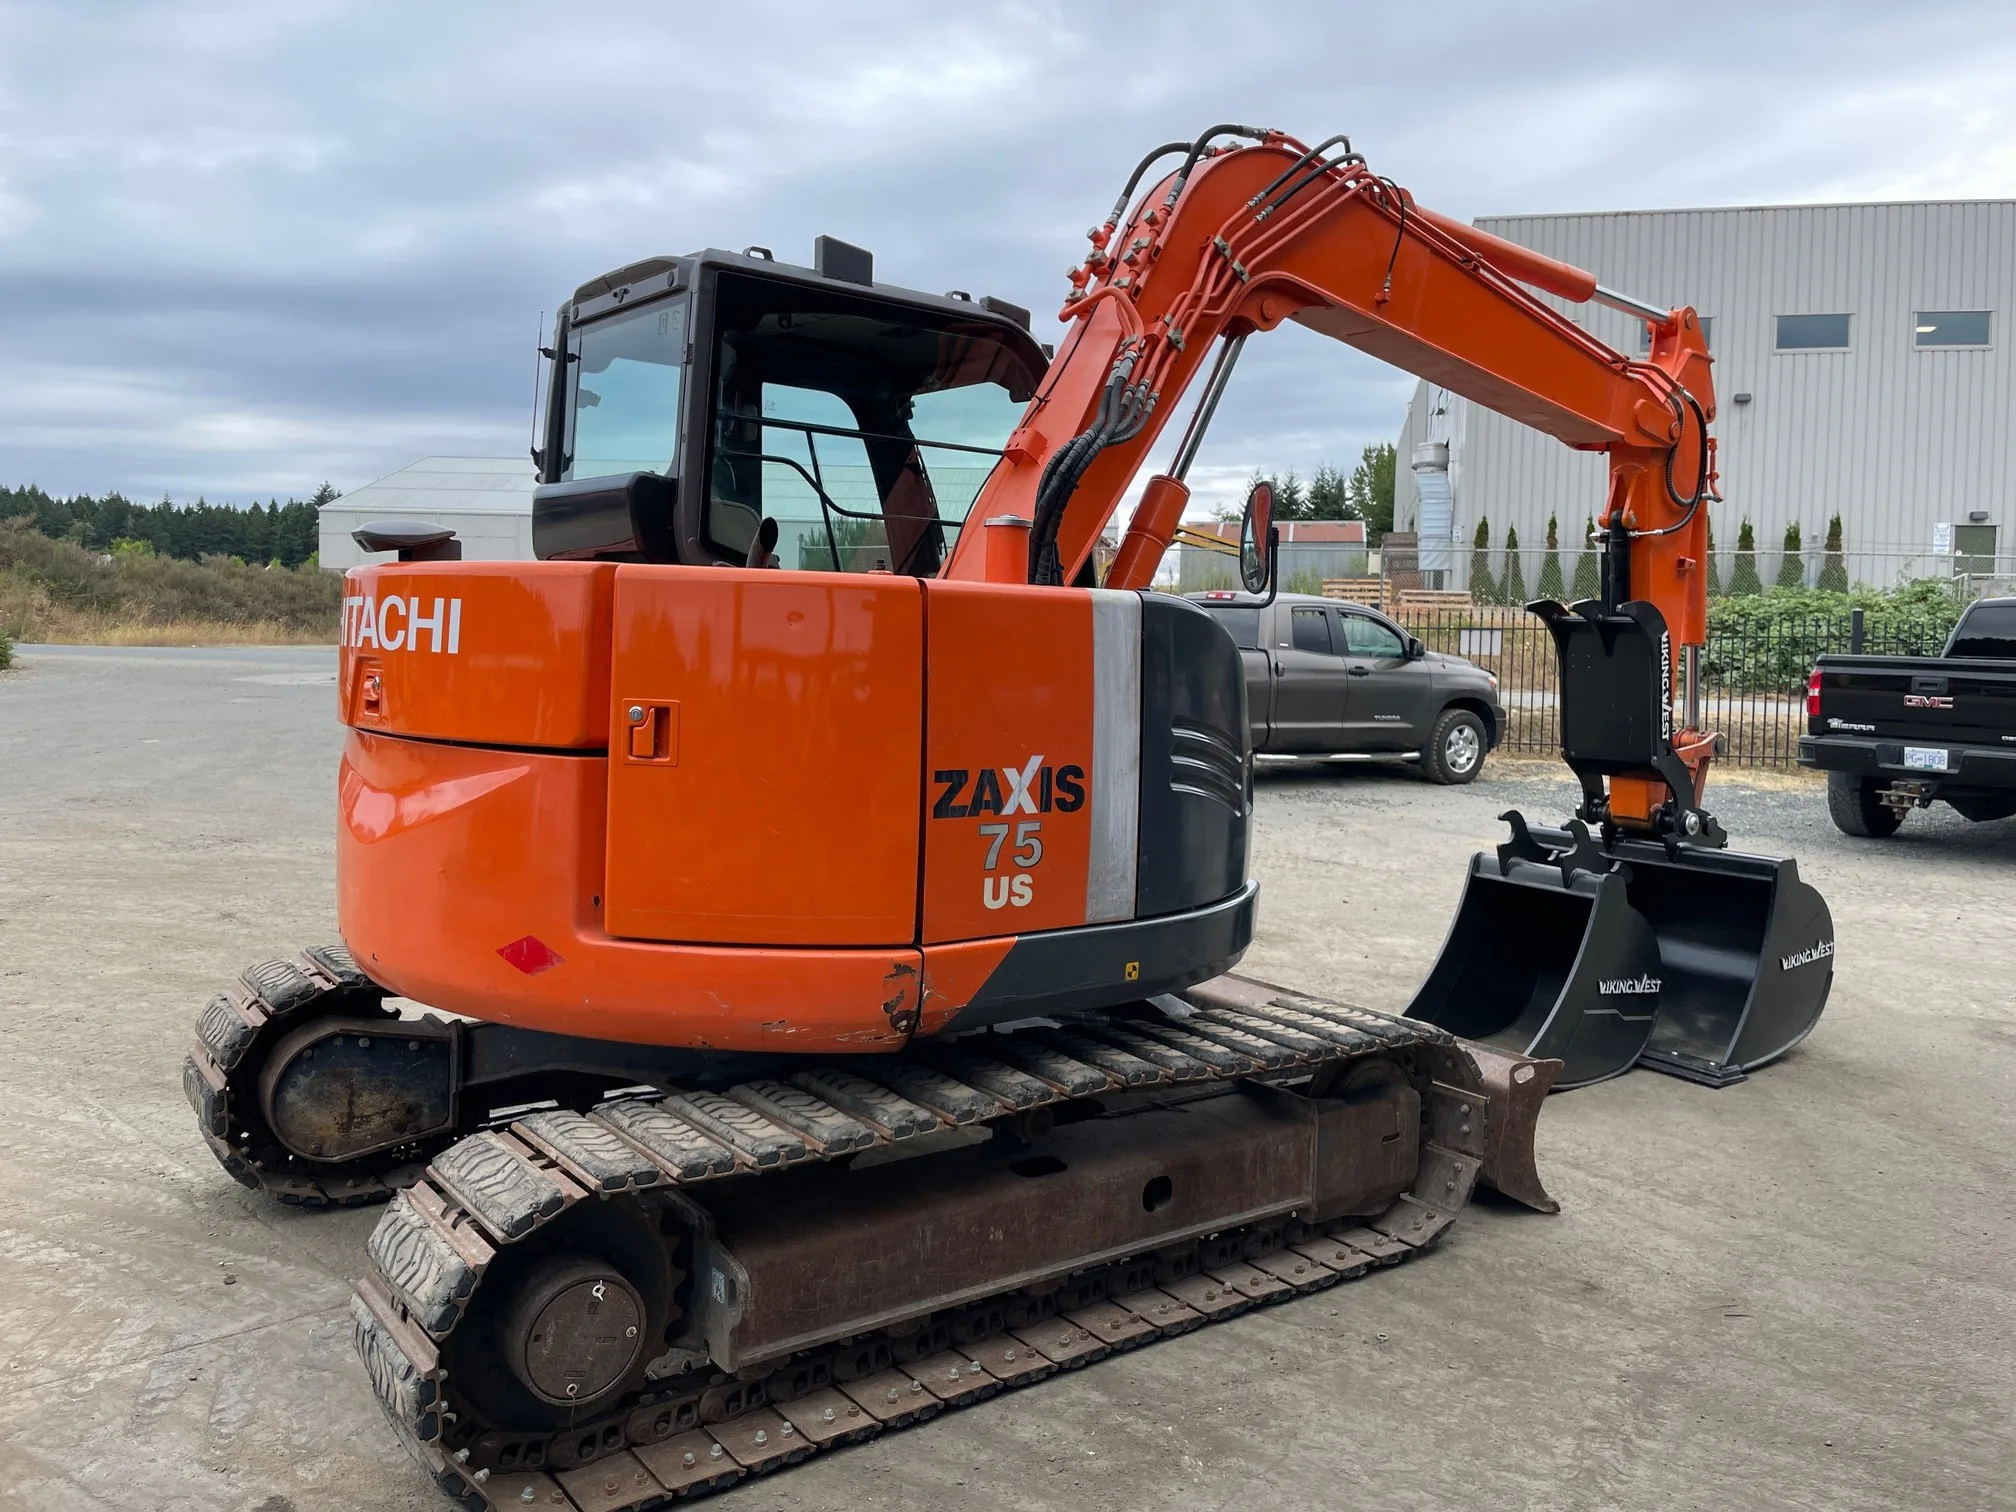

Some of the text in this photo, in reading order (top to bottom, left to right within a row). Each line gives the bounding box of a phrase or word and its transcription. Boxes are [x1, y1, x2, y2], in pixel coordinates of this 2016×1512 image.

[1904, 694, 1954, 709] GMC
[933, 754, 1085, 819] ZAXIS
[979, 821, 1044, 871] 75
[983, 873, 1033, 909] US
